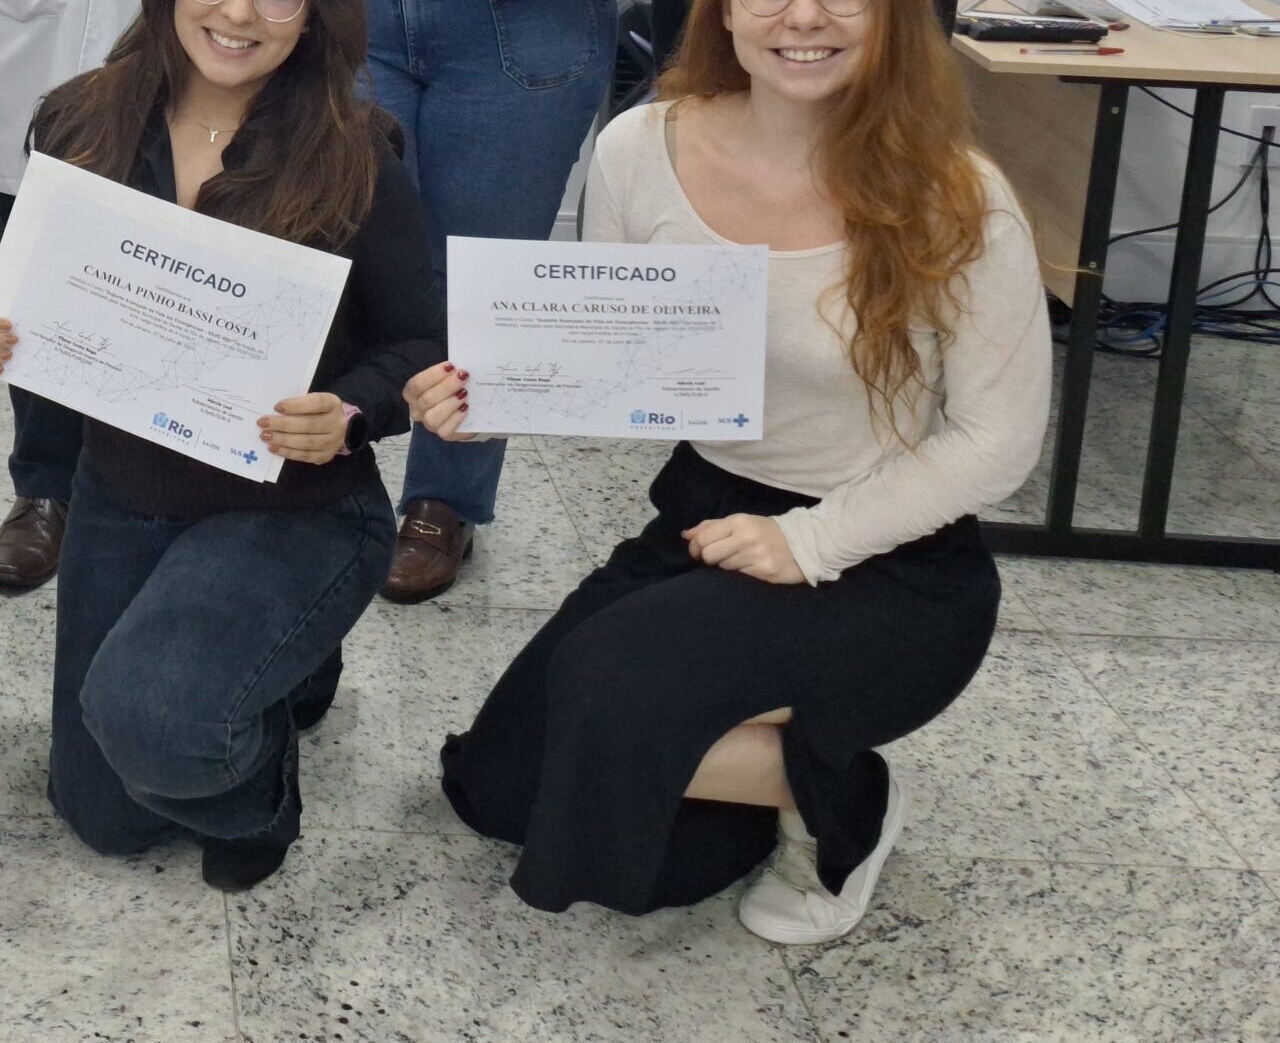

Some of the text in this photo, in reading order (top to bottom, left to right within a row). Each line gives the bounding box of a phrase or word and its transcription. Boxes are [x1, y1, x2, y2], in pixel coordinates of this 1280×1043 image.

[120, 239, 246, 298] CERTIFICADO
[534, 264, 676, 283] CERTIFICADO
[84, 264, 258, 340] CAMILA PINHO BASSI COSTA
[490, 301, 721, 316] ANA CLARA CARUSO DE OLIVEIRA
[648, 412, 675, 425] Rio
[168, 419, 193, 438] Rio
